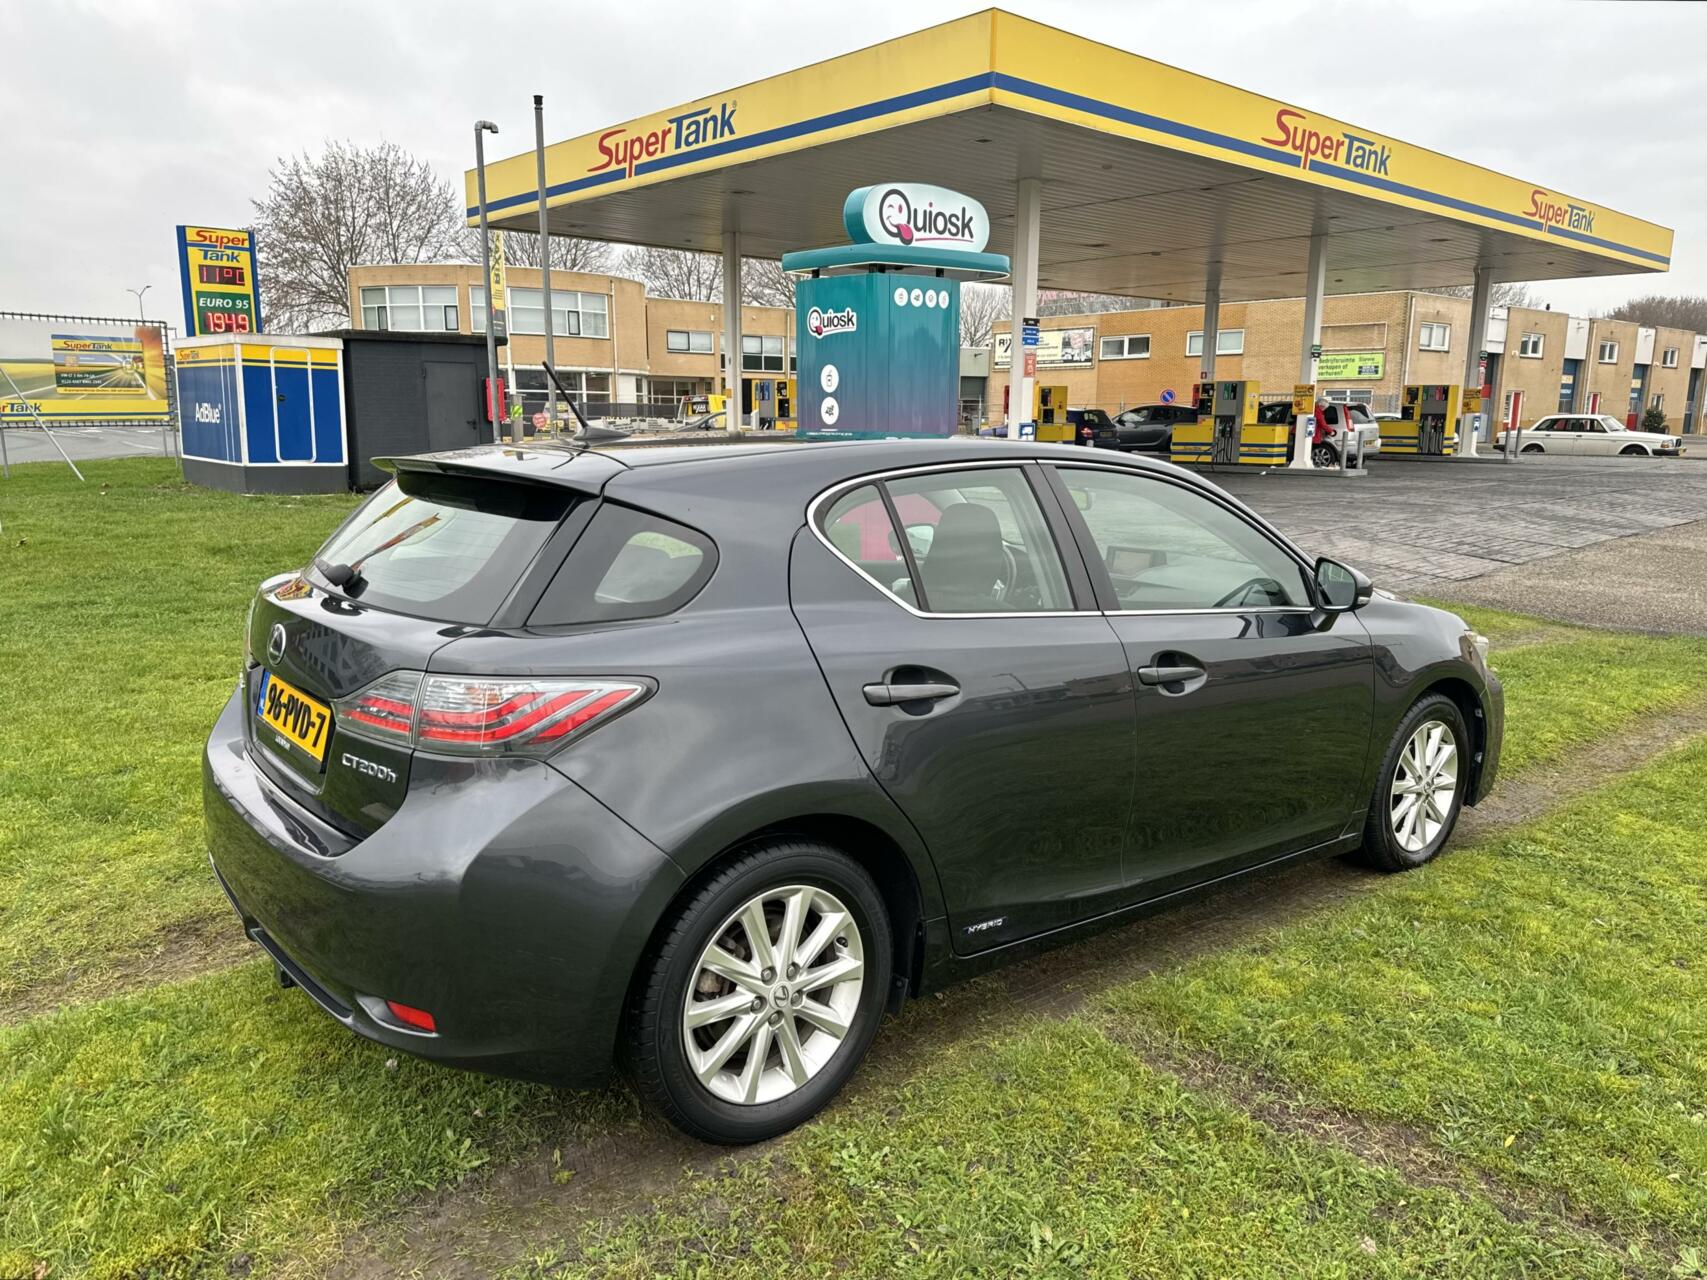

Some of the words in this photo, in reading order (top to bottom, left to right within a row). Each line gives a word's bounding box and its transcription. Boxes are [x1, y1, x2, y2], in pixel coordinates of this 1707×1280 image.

[587, 102, 737, 178] SuperTank
[1261, 108, 1392, 176] SuperTank
[879, 188, 974, 245] Quiosk
[1523, 189, 1594, 233] SuperTank
[187, 230, 248, 249] Super
[198, 249, 241, 263] Tank
[199, 298, 232, 308] EURO
[236, 300, 249, 309] 95
[808, 308, 855, 336] Quiosk
[63, 341, 112, 352] SuperTank
[0, 402, 42, 413] rTank
[195, 402, 220, 424] AdBlue
[266, 683, 327, 748] 96-PVD-7
[341, 752, 398, 783] CT200h
